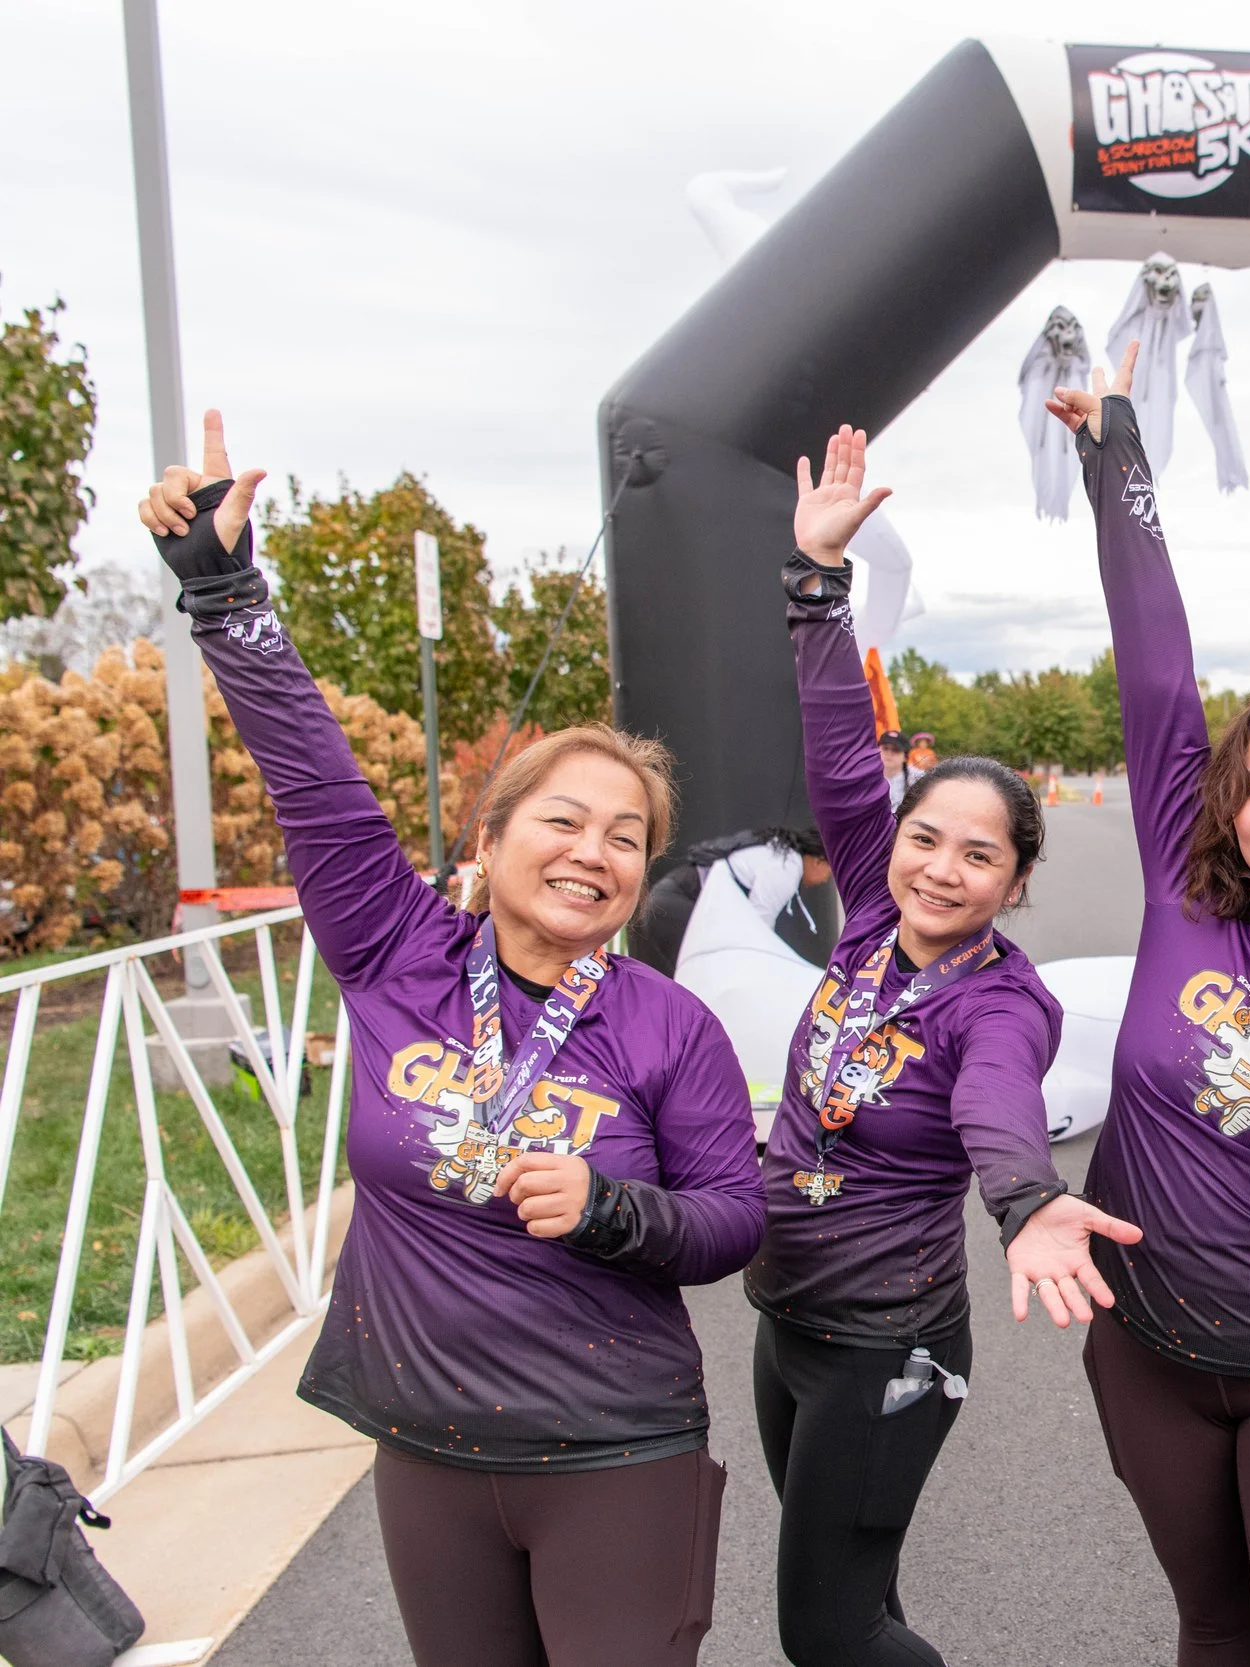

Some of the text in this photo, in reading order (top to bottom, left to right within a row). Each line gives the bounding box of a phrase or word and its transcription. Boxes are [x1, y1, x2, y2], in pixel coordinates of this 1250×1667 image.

[468, 954, 498, 1011] 5K
[938, 963, 950, 974] &
[532, 998, 576, 1056] 5K
[840, 989, 876, 1045] 5K
[472, 1003, 504, 1104] GHOST
[529, 1051, 538, 1068] RUN
[554, 1074, 576, 1084] run
[577, 1073, 590, 1085] &
[793, 1171, 844, 1190] GHOST
